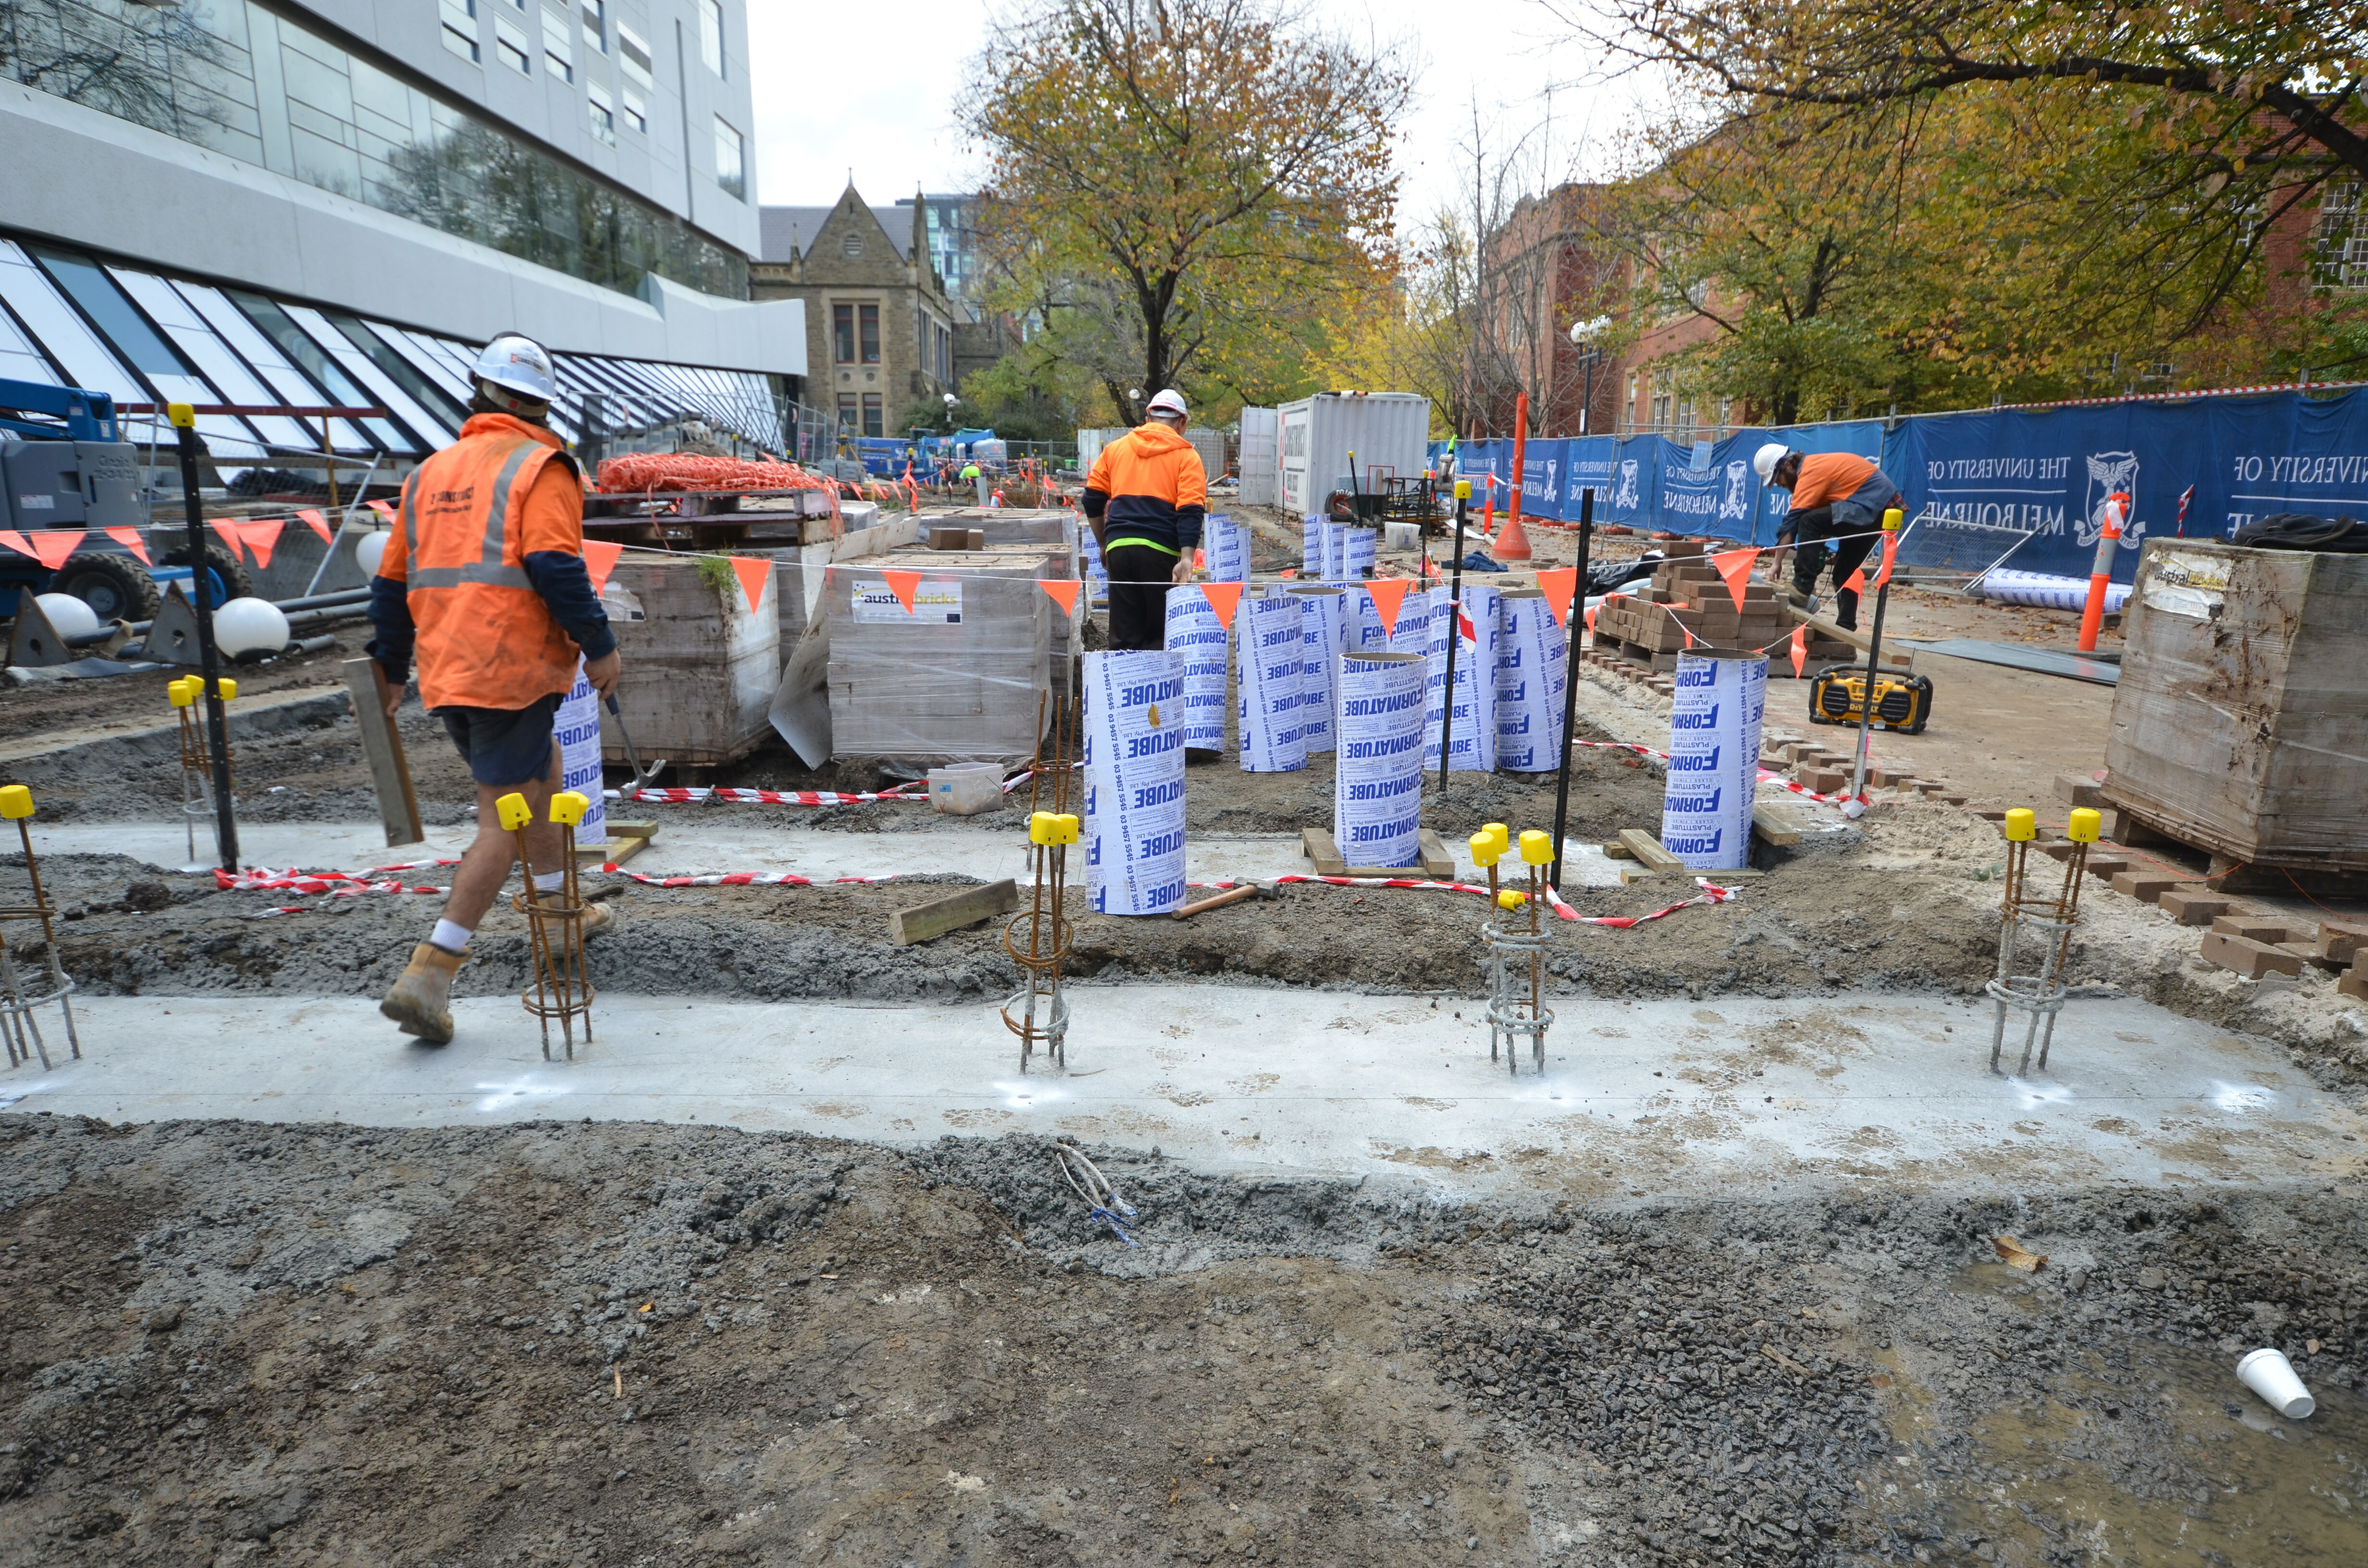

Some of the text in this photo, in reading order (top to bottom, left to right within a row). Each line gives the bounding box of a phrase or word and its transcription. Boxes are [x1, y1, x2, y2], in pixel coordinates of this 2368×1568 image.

[1394, 635, 1426, 646] PLASTITUBE
[1102, 663, 1109, 672] 03
[1384, 675, 1420, 689] PLASTITUBE
[1345, 677, 1424, 716] FORMATUBE
[1108, 714, 1114, 723] 03
[1387, 716, 1421, 731] PLASTITUBE
[1110, 724, 1118, 741] 9457
[1112, 743, 1121, 761] 5545
[1114, 764, 1134, 861] 03 9457 5545 03 9457 5545
[1126, 865, 1140, 911] 03 9457 5545
